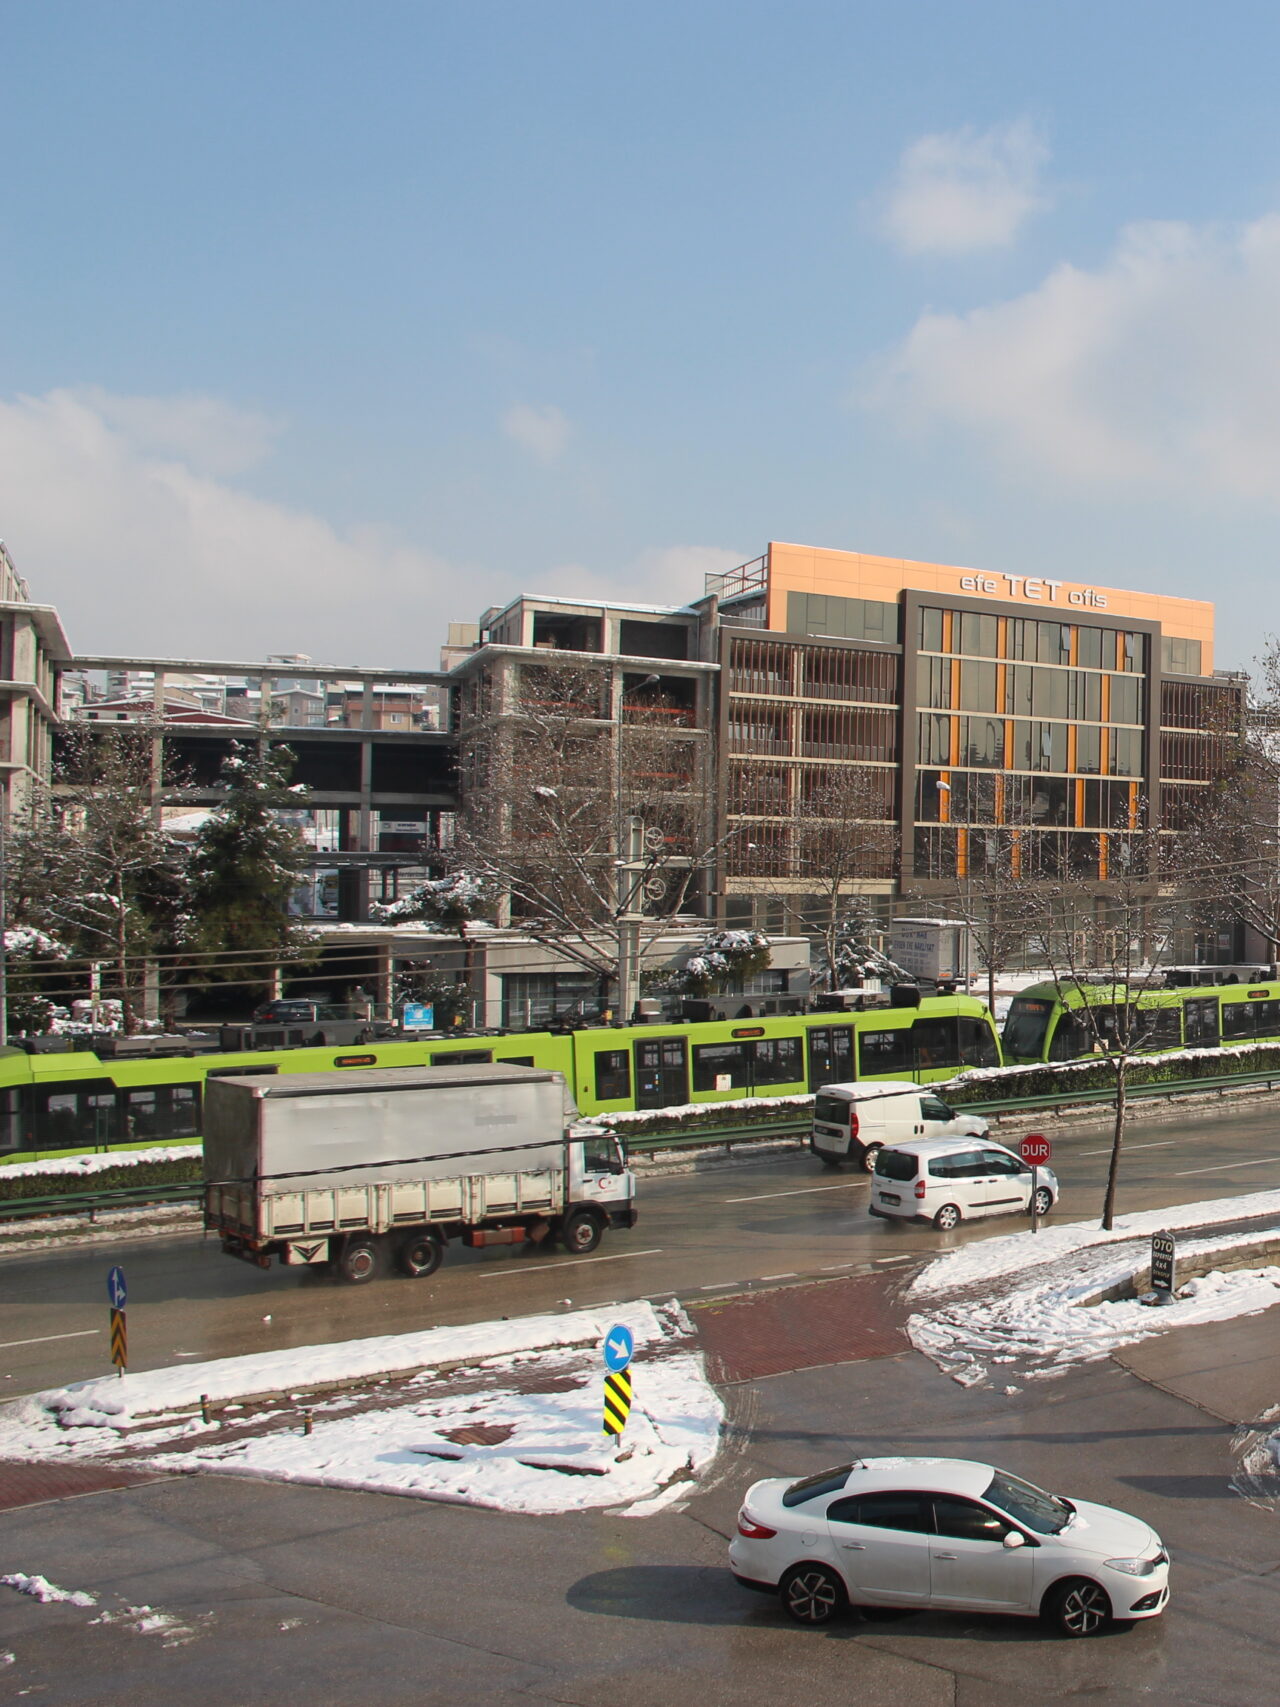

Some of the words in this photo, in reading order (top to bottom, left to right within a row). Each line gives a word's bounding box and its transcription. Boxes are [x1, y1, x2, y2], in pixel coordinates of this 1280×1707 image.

[960, 574, 997, 593] efe
[1003, 574, 1062, 601] TET
[1068, 588, 1108, 608] ofis
[1021, 1144, 1048, 1156] DUR
[1153, 1239, 1172, 1253] OTO
[1155, 1260, 1167, 1270] 4x4
